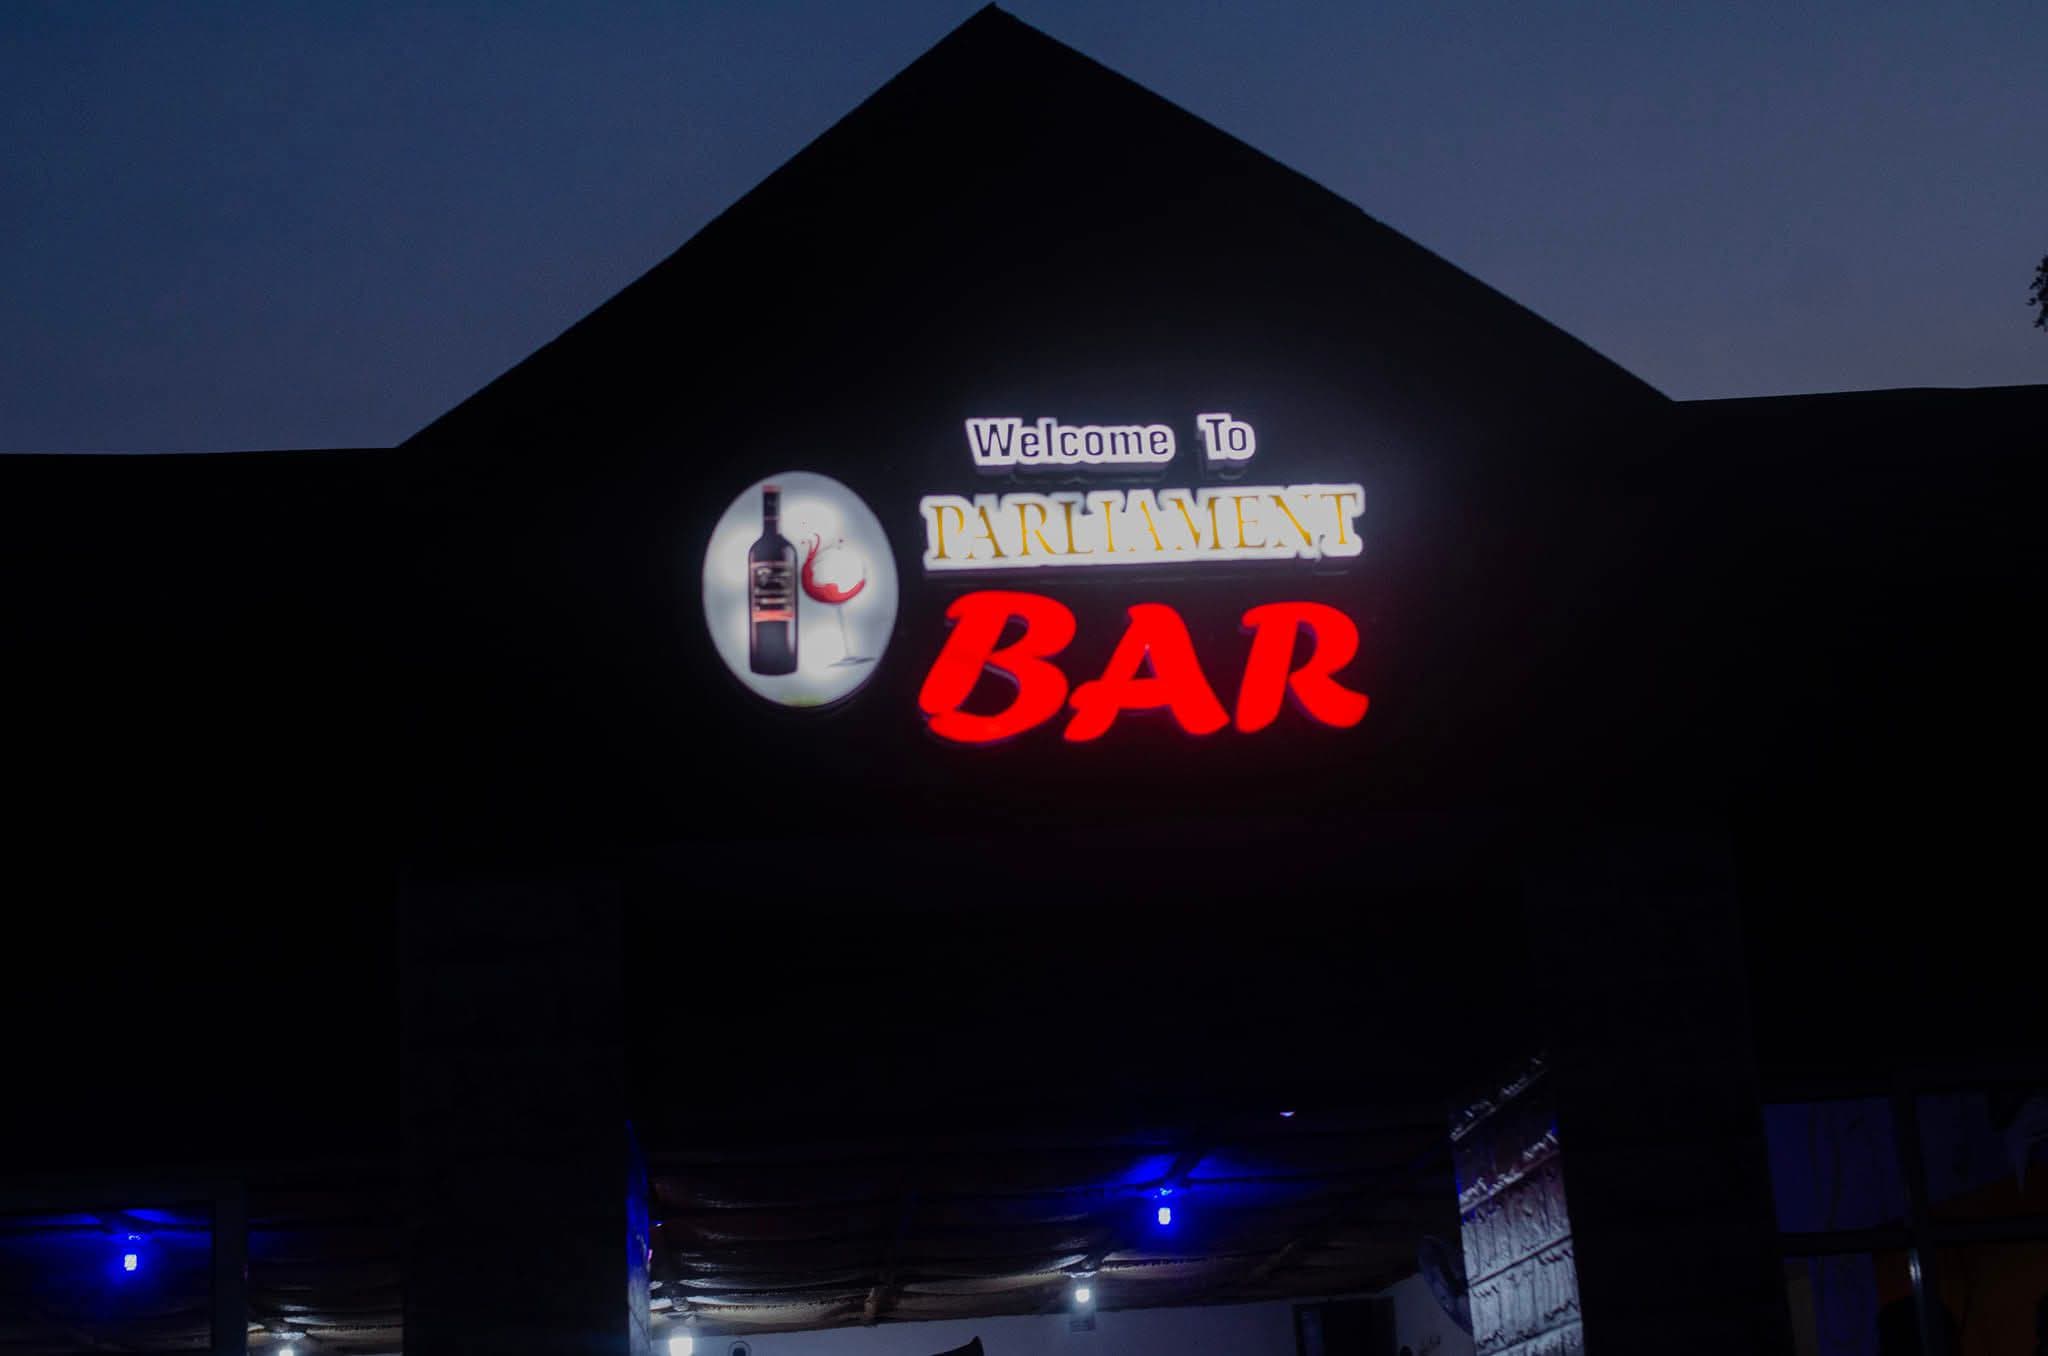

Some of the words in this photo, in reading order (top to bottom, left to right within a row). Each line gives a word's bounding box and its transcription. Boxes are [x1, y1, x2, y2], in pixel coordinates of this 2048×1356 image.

[973, 422, 1169, 458] Welcome
[1206, 418, 1248, 453] To
[930, 492, 1358, 560] PARLIAMENT
[918, 591, 1369, 741] BAR
